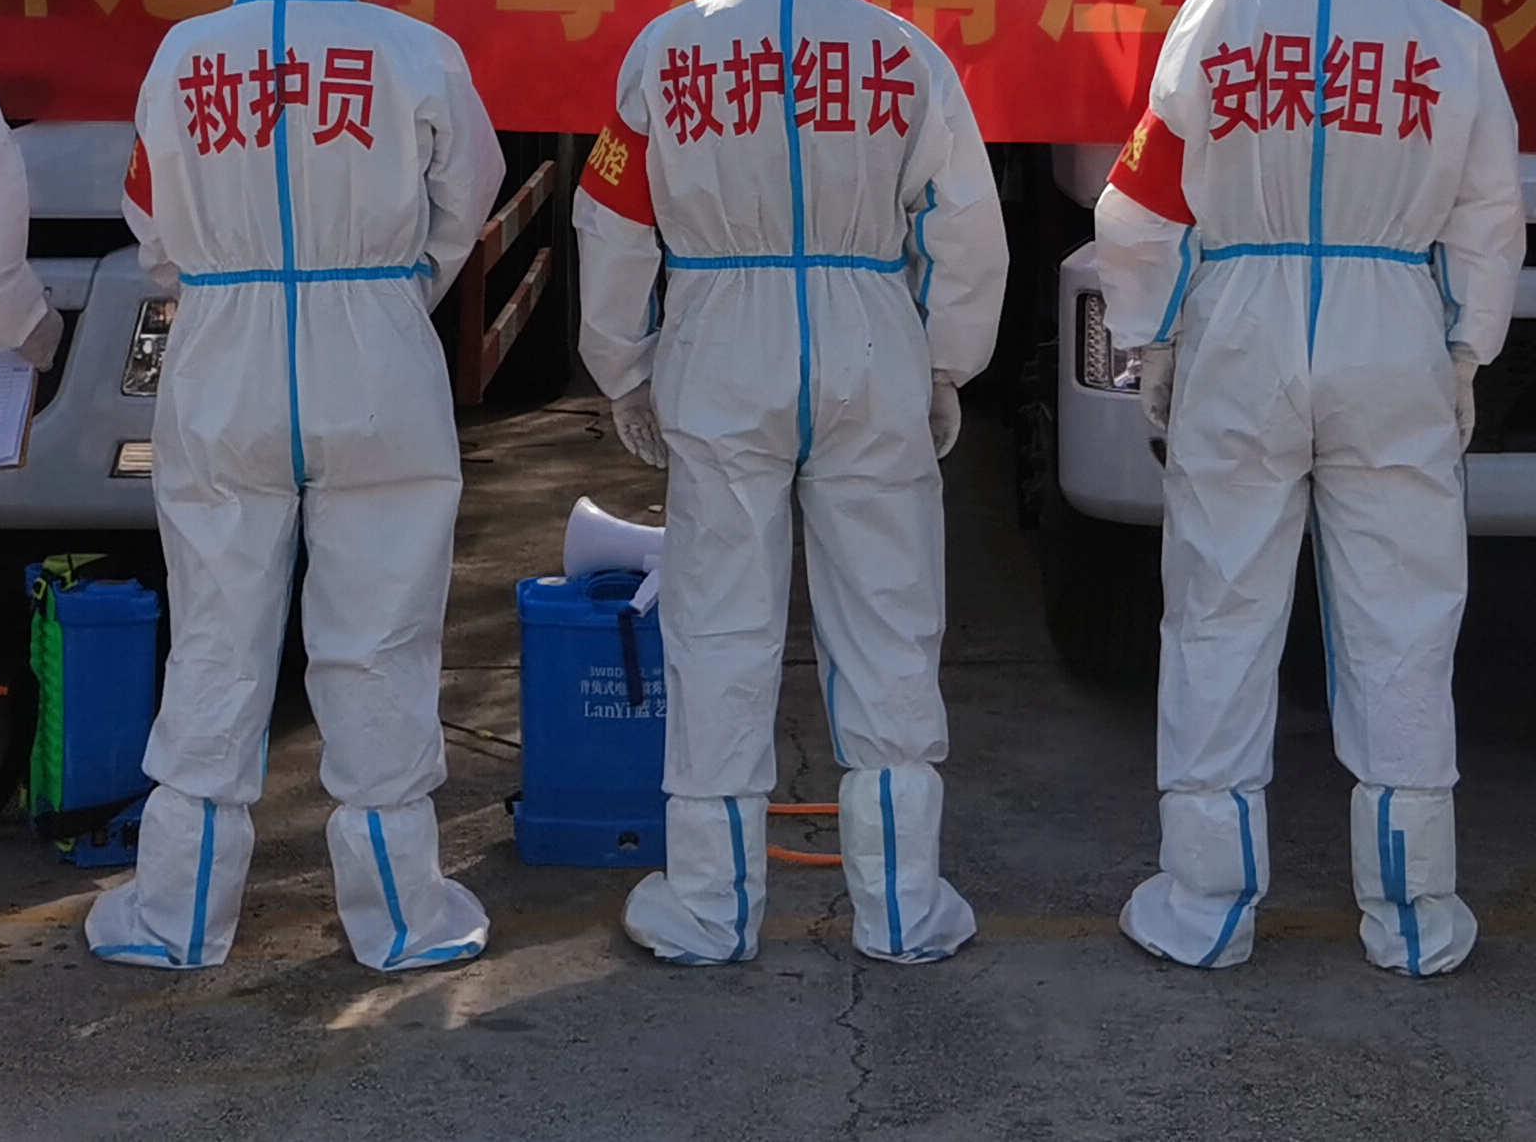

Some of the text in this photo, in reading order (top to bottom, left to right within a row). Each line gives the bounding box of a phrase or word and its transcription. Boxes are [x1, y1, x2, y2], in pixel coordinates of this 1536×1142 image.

[178, 47, 374, 156] 救护员
[660, 37, 915, 146] 救护组长
[1200, 32, 1441, 145] 安保组长
